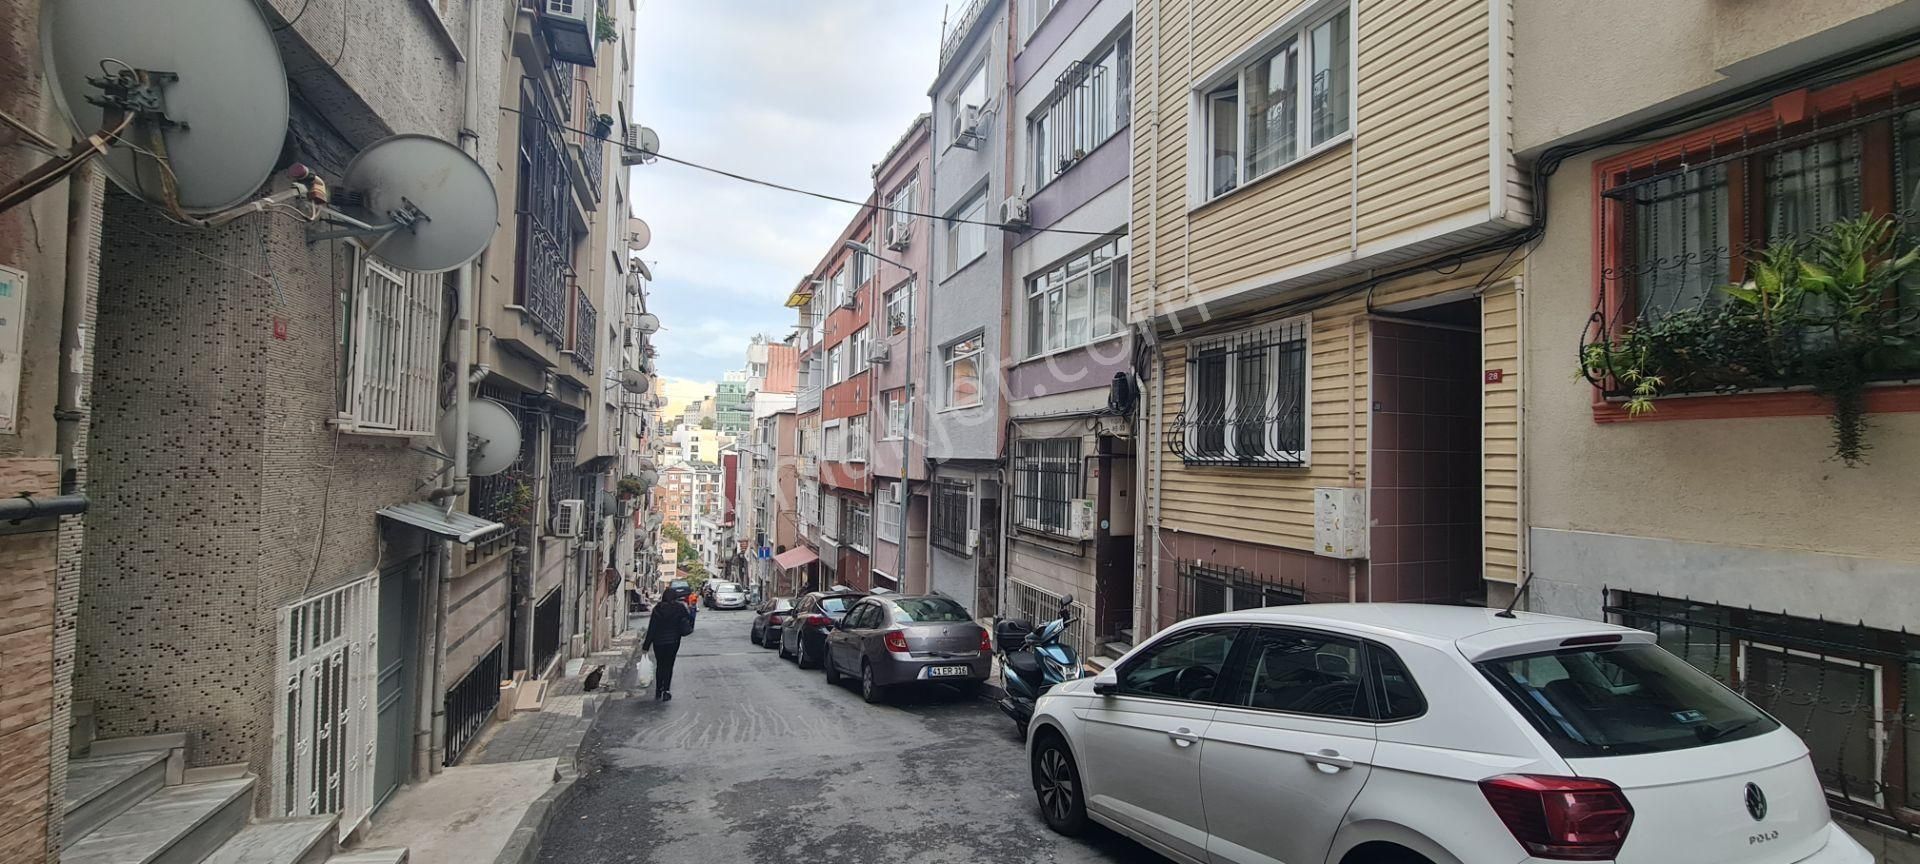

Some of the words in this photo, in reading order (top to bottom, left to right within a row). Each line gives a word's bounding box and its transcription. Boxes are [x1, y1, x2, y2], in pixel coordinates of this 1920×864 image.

[1488, 372, 1498, 381] 28
[933, 667, 941, 675] 41
[1749, 830, 1779, 845] POLO
